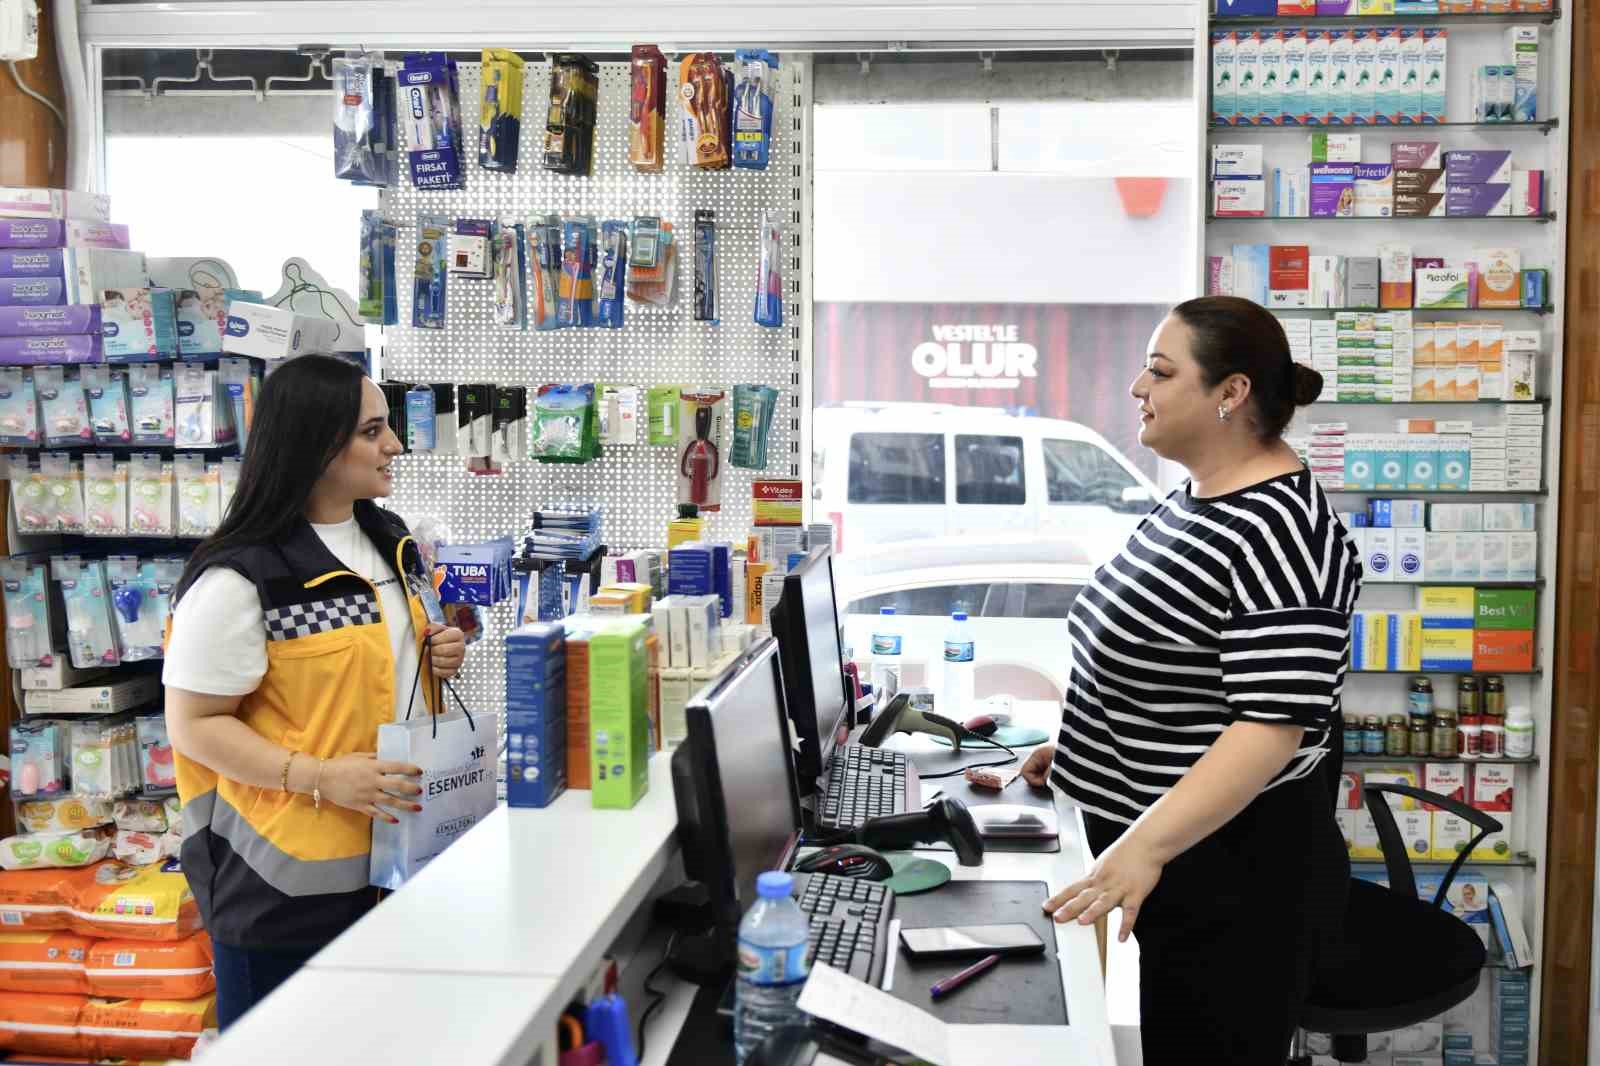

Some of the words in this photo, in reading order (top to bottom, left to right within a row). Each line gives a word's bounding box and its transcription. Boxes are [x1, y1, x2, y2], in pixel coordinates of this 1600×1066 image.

[416, 161, 447, 173] FIRSAT
[932, 324, 1019, 342] VESTEL'LE
[911, 341, 1038, 377] OLUR
[452, 565, 487, 577] TUBA
[428, 768, 485, 796] ESENYURT
